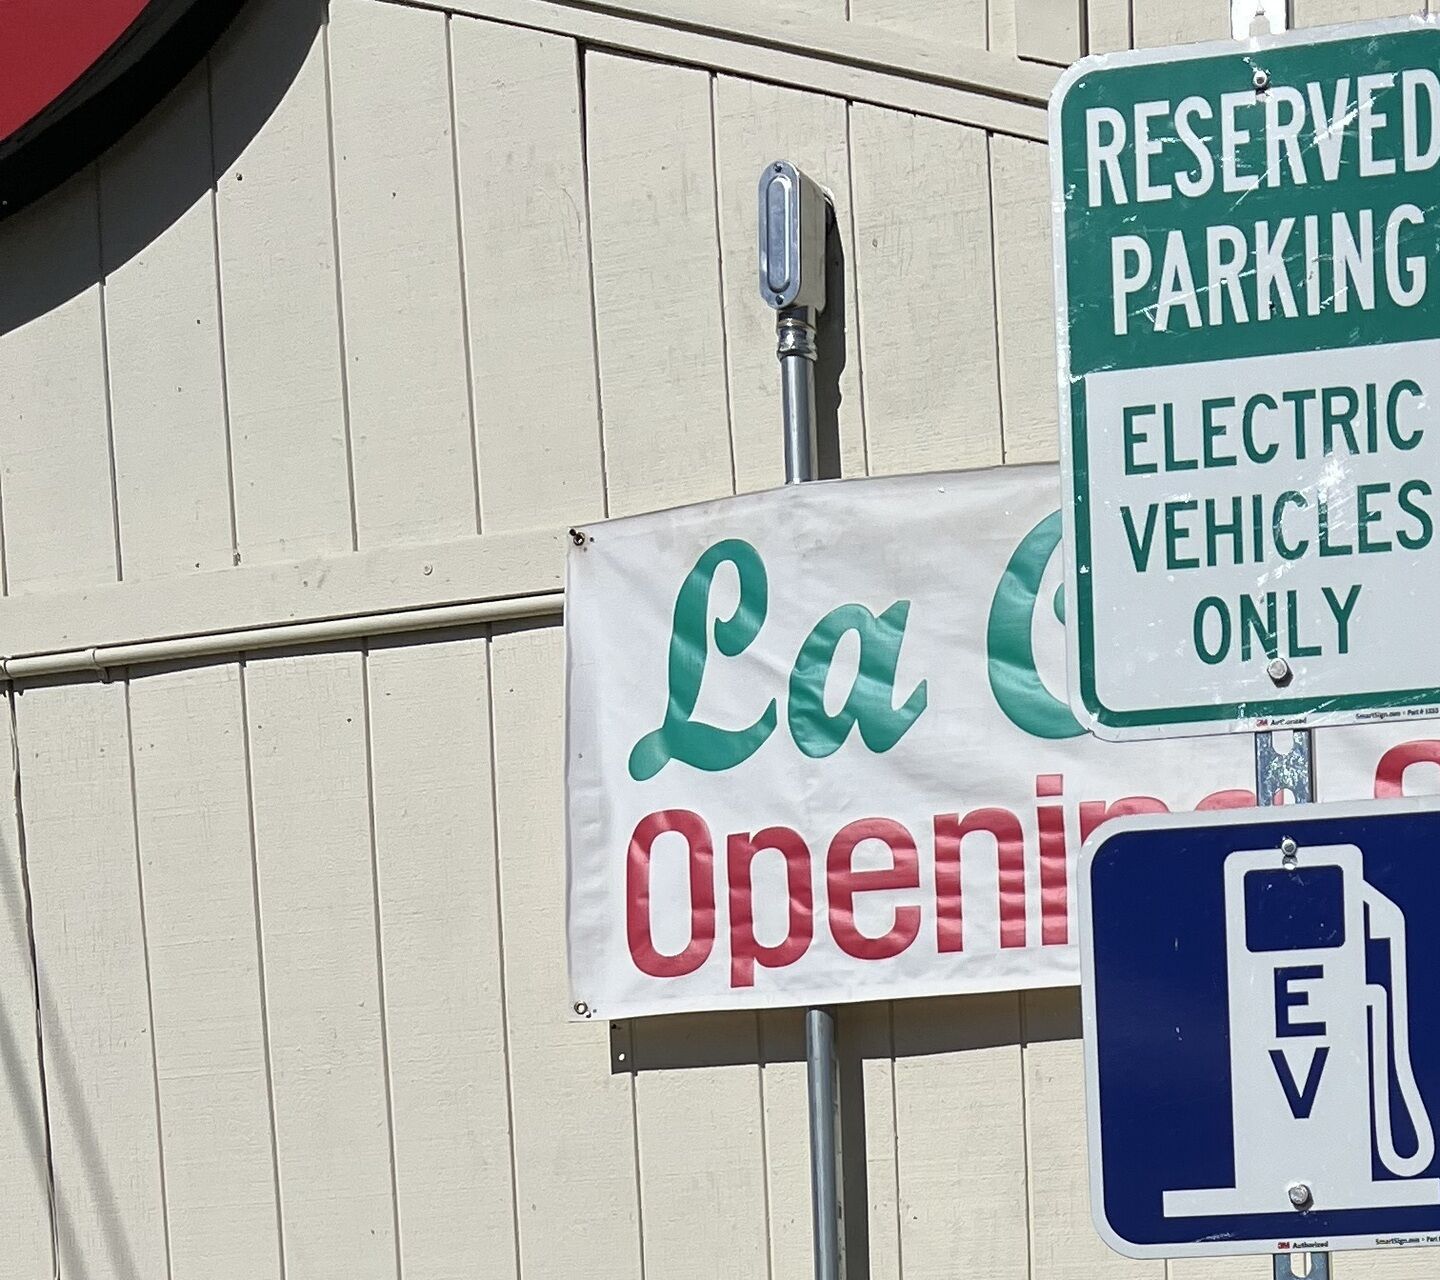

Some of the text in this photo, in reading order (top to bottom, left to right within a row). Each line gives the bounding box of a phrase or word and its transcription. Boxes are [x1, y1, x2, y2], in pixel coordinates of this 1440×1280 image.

[1111, 204, 1428, 335] PARKING
[1122, 379, 1425, 476] ELECTRIC
[1120, 479, 1434, 573] VEHICLES
[628, 538, 928, 781] La
[1193, 584, 1363, 665] ONLY
[626, 773, 1285, 988] Openi
[1267, 964, 1331, 1120] EV
